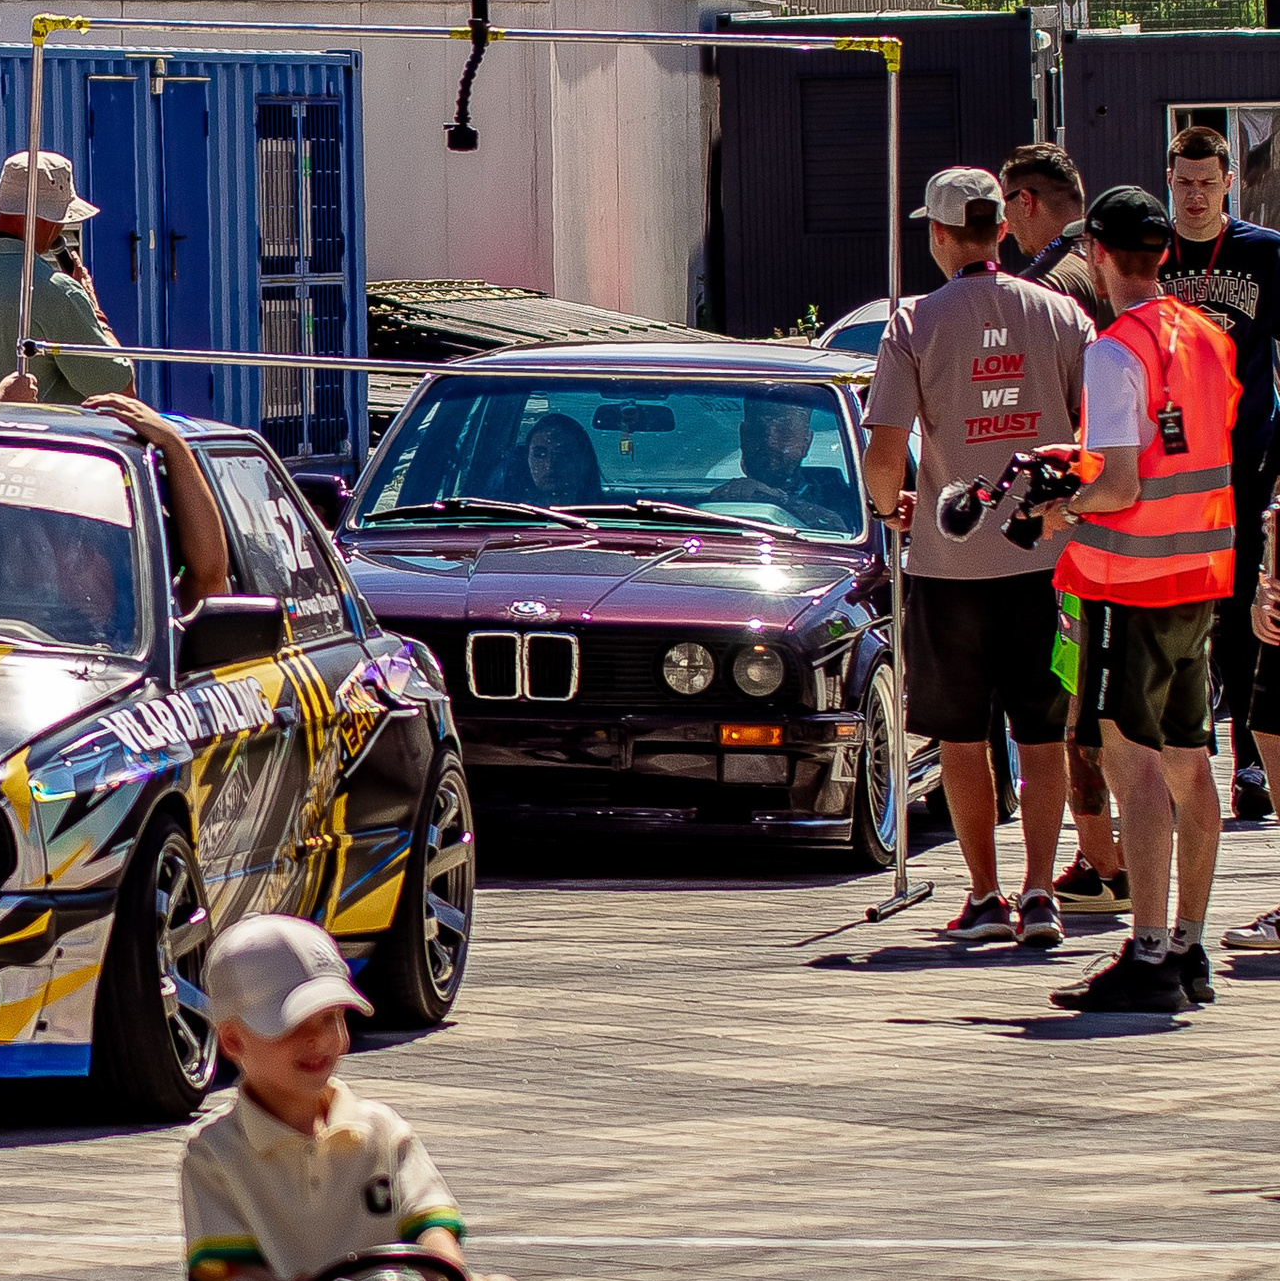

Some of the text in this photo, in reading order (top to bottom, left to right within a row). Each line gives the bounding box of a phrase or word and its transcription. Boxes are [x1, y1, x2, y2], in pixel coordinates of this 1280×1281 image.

[1165, 269, 1252, 279] UTHENTIC
[1160, 275, 1259, 319] ORTSWEAR
[972, 354, 1025, 376] LOW
[982, 388, 1020, 408] WE
[964, 412, 1042, 437] TRUST
[264, 497, 315, 572] 52
[97, 699, 187, 754] VILAR
